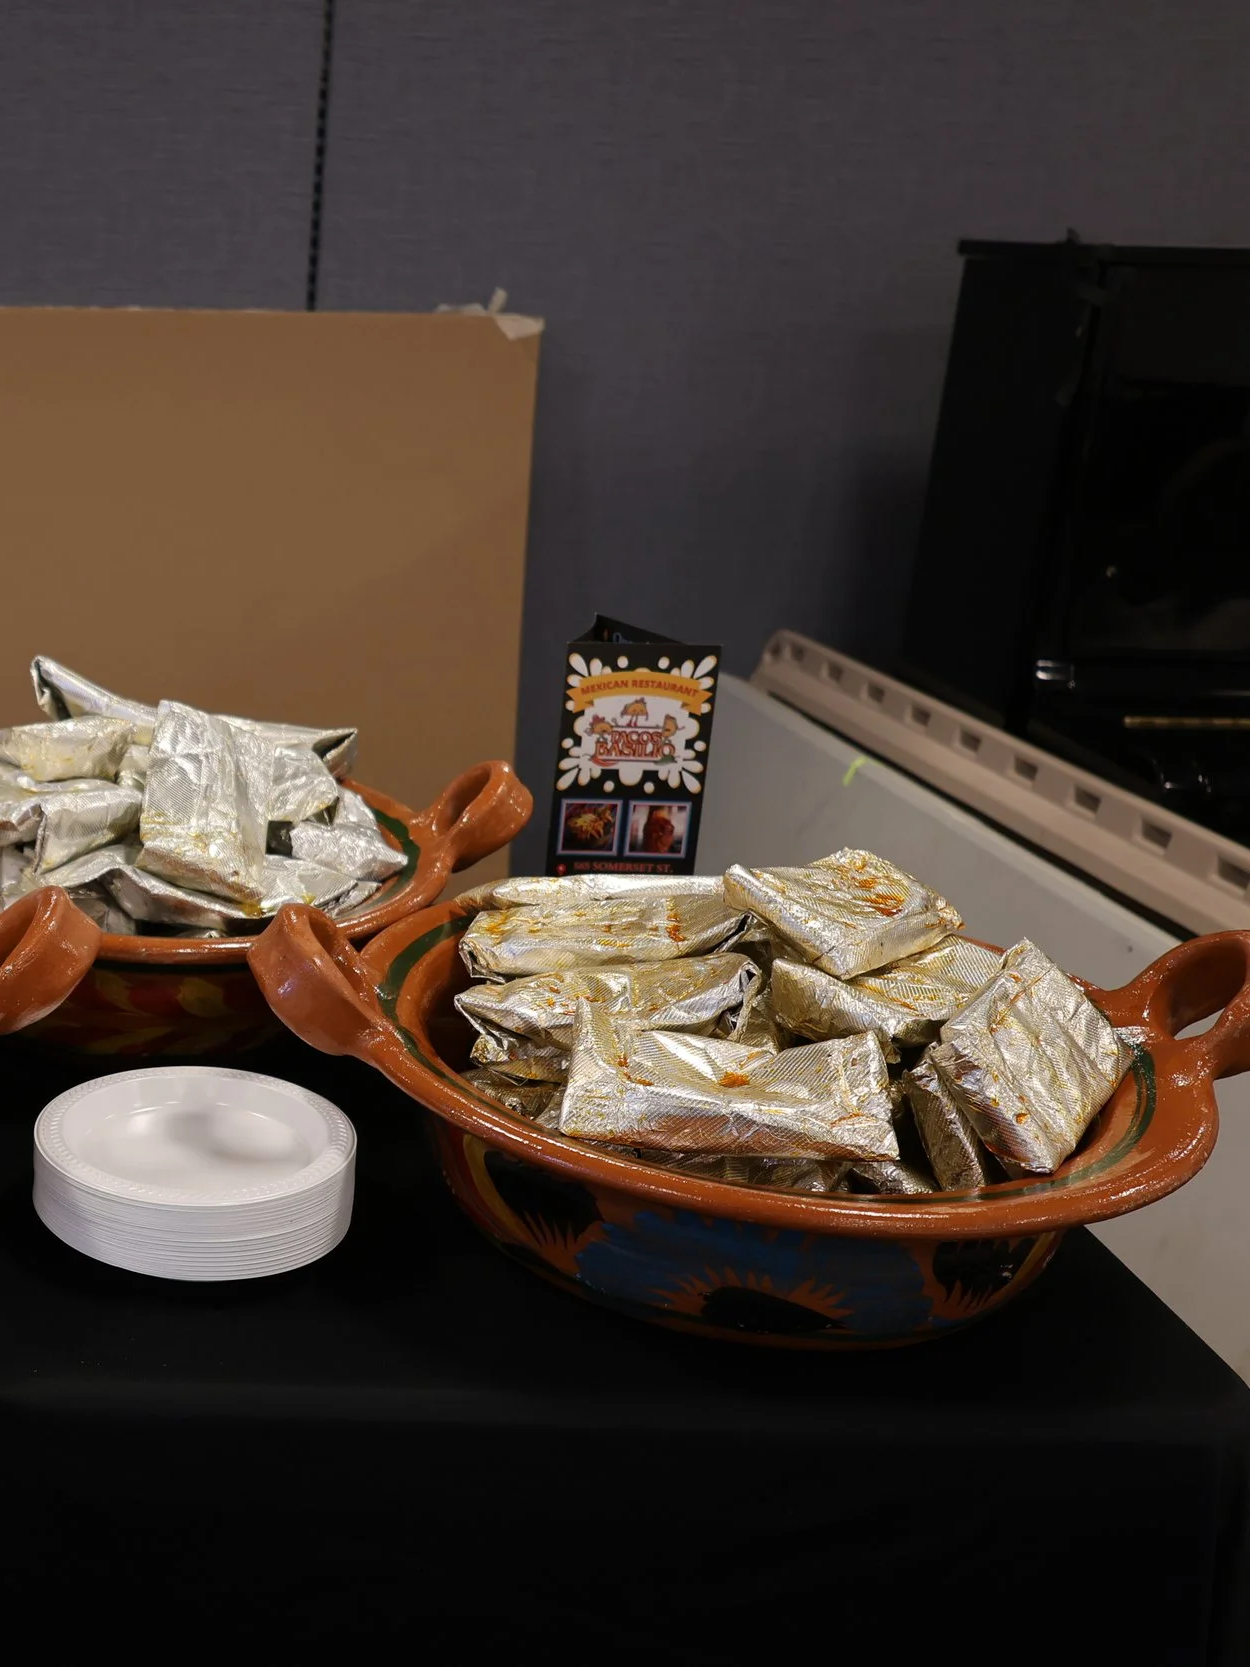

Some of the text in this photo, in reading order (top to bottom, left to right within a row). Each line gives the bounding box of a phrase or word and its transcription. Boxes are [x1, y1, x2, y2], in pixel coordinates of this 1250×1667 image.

[581, 678, 699, 698] MEXICAN RESTAURANT
[609, 730, 663, 744] TACOS
[594, 741, 677, 759] BASILIO
[592, 861, 654, 873] SOMERSET
[656, 863, 674, 873] ST.
